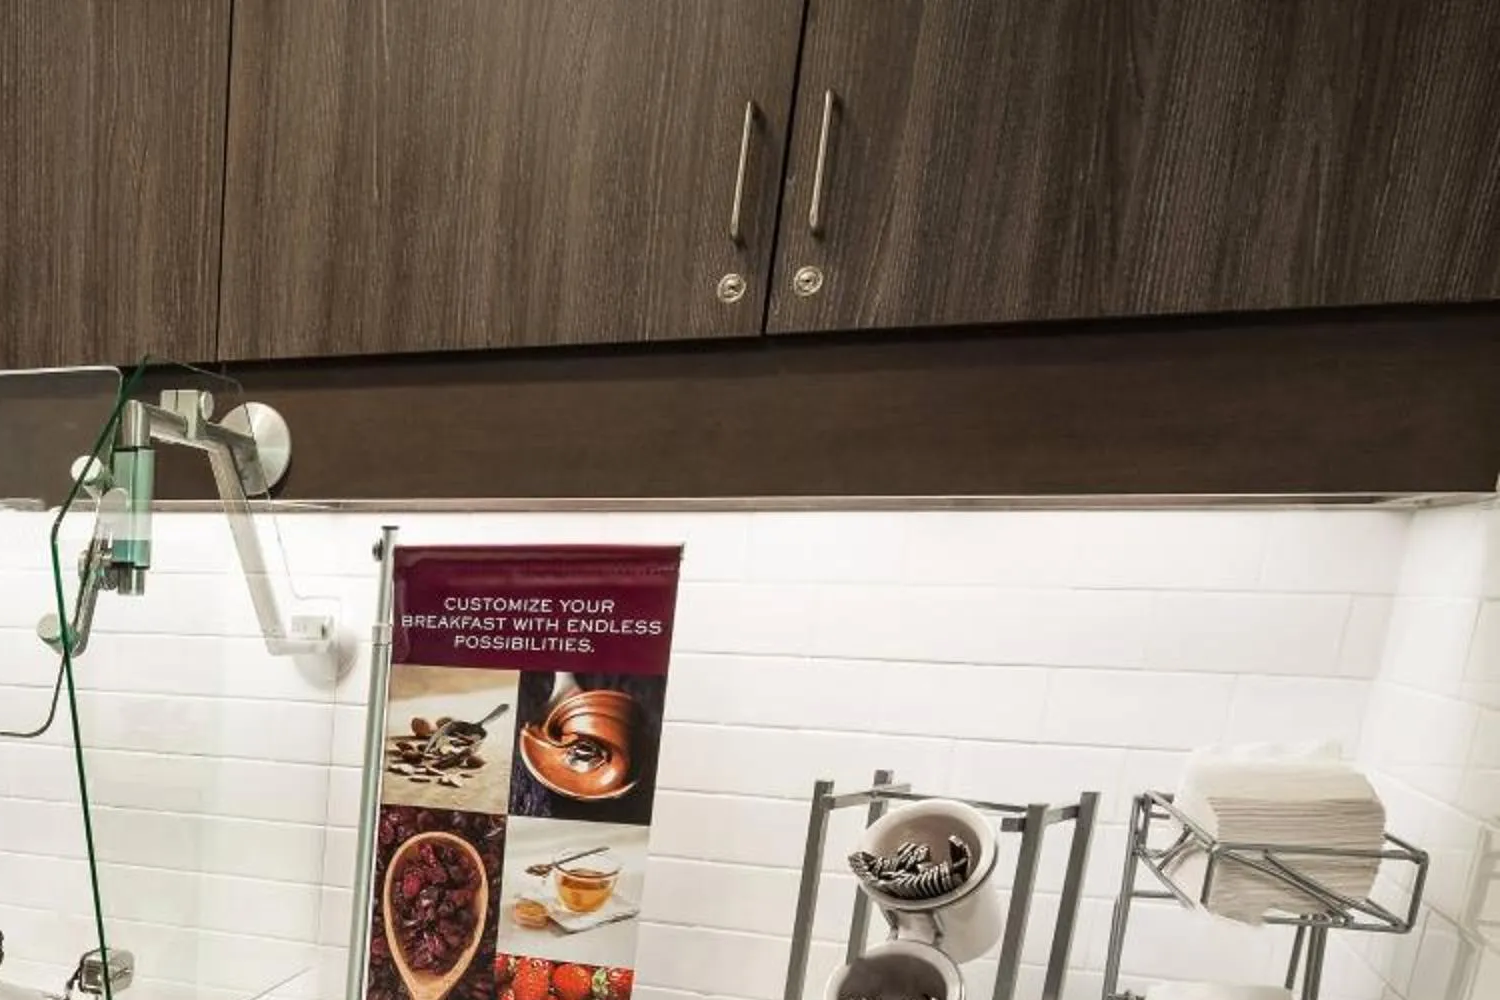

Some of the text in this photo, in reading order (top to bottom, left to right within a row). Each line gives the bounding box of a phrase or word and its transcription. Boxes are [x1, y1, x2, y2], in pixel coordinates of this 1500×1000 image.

[444, 597, 615, 614] CUSTOMIZE YOUR
[401, 615, 662, 635] BREAKFAST WITH ENDLESS
[453, 635, 595, 653] POSSIBILITIES.
